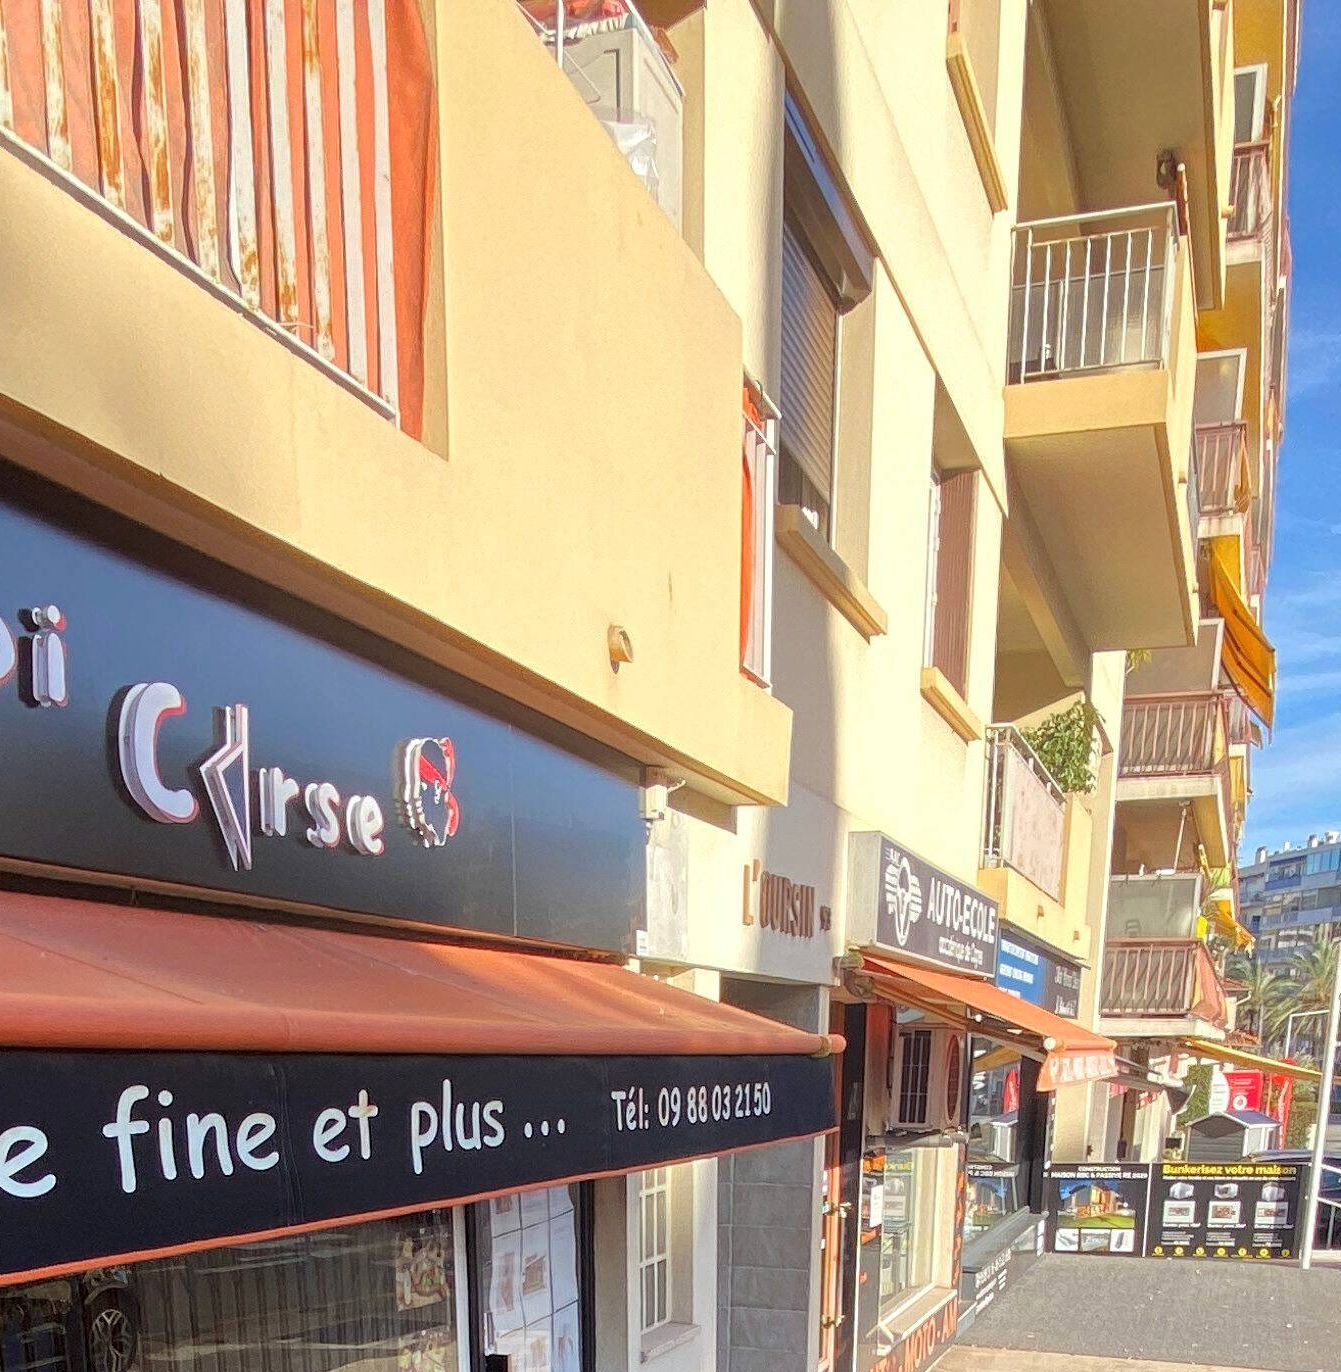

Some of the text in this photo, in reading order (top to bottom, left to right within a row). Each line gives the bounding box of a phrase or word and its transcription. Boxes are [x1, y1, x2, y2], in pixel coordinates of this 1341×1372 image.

[742, 858, 816, 939] L'OURSIN
[103, 1084, 280, 1194] fine
[313, 1089, 379, 1163] et
[410, 1078, 506, 1175] plus
[611, 1086, 650, 1131] Tél:
[658, 1086, 681, 1127] 09
[687, 1085, 708, 1124] 88
[712, 1084, 731, 1121] 03
[1162, 1164, 1224, 1175] Bunkerisez
[1224, 1164, 1254, 1175] votre
